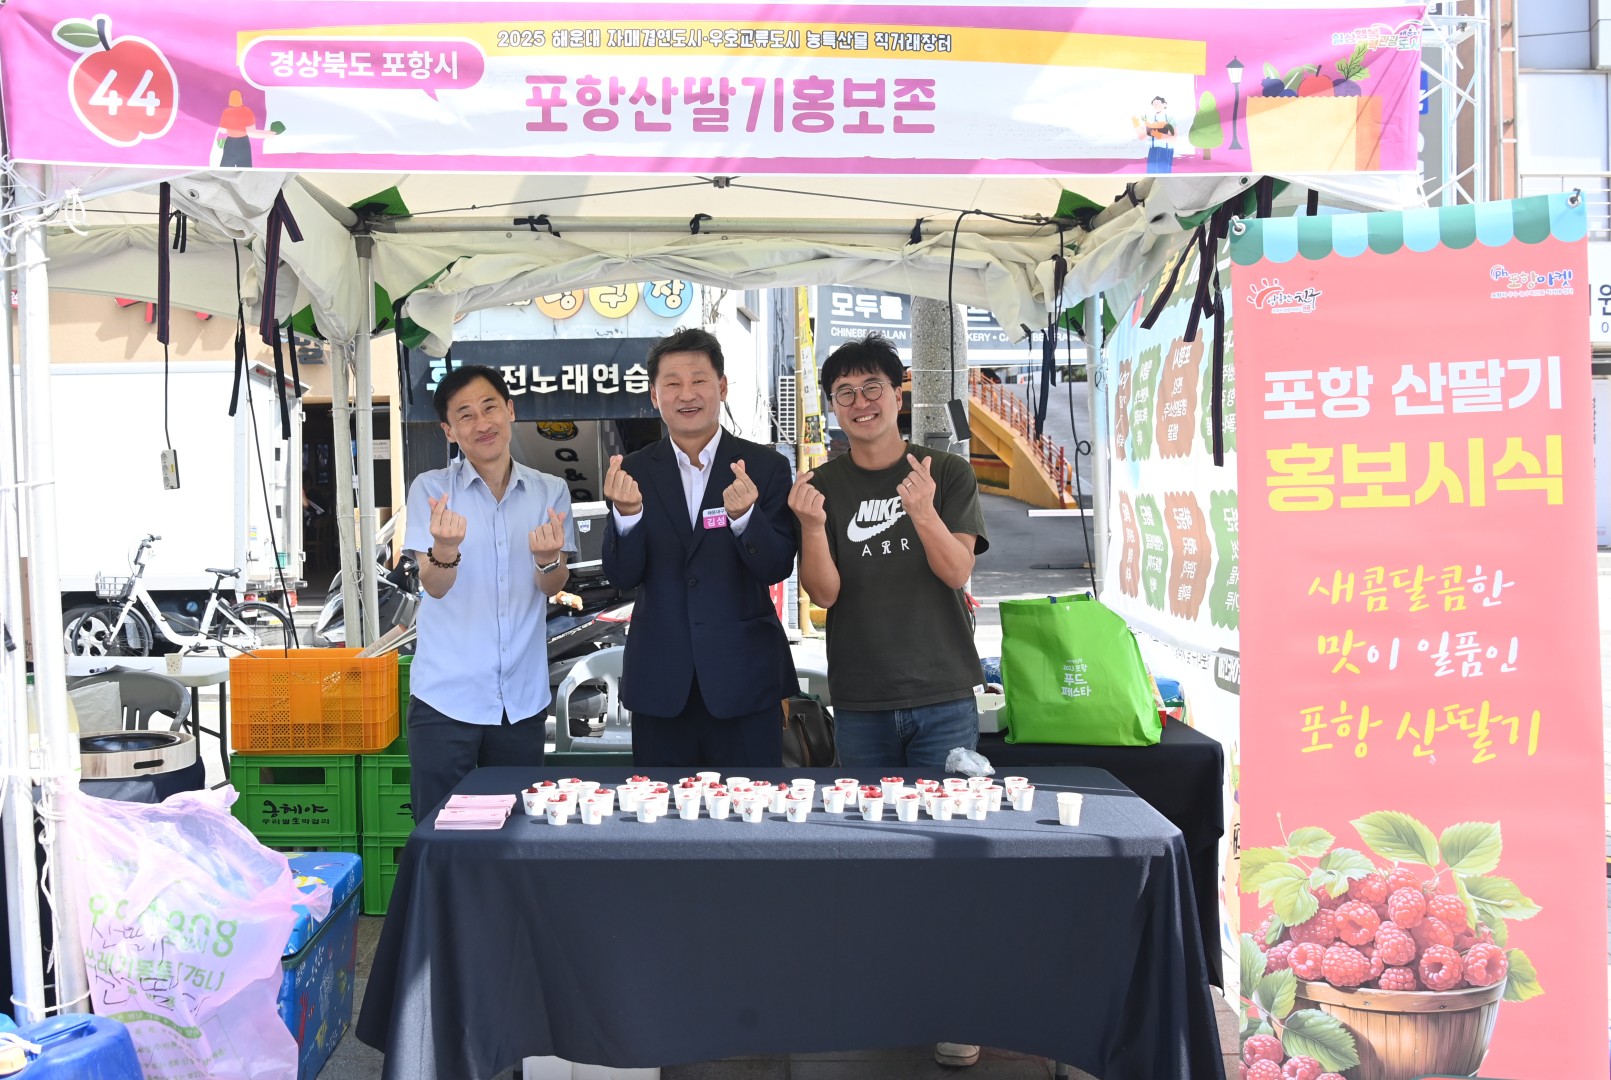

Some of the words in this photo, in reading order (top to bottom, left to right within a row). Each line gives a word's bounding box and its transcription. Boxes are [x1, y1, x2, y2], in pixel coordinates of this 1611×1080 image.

[497, 30, 546, 48] 2025
[552, 29, 601, 48] 해운대
[806, 31, 869, 51] 농특산물
[874, 31, 953, 53] 직거래장터
[269, 51, 374, 79] 경상북도
[381, 51, 459, 80] 포항시
[88, 69, 161, 117] 44
[525, 74, 936, 134] 포항산딸기홍보존
[967, 332, 991, 342] KERY
[1263, 365, 1374, 420] 포항
[1391, 355, 1562, 416] 산딸기
[1266, 434, 1563, 512] 홍보시식
[857, 496, 902, 522] NIKE
[1307, 564, 1515, 613] 새콤달콤한
[1317, 628, 1401, 674] 맛이
[1417, 631, 1519, 678] 일품인
[1061, 686, 1092, 697] 페스타
[1064, 673, 1088, 686] 푸드
[1299, 700, 1384, 758] 포항
[1395, 700, 1541, 764] 산딸기
